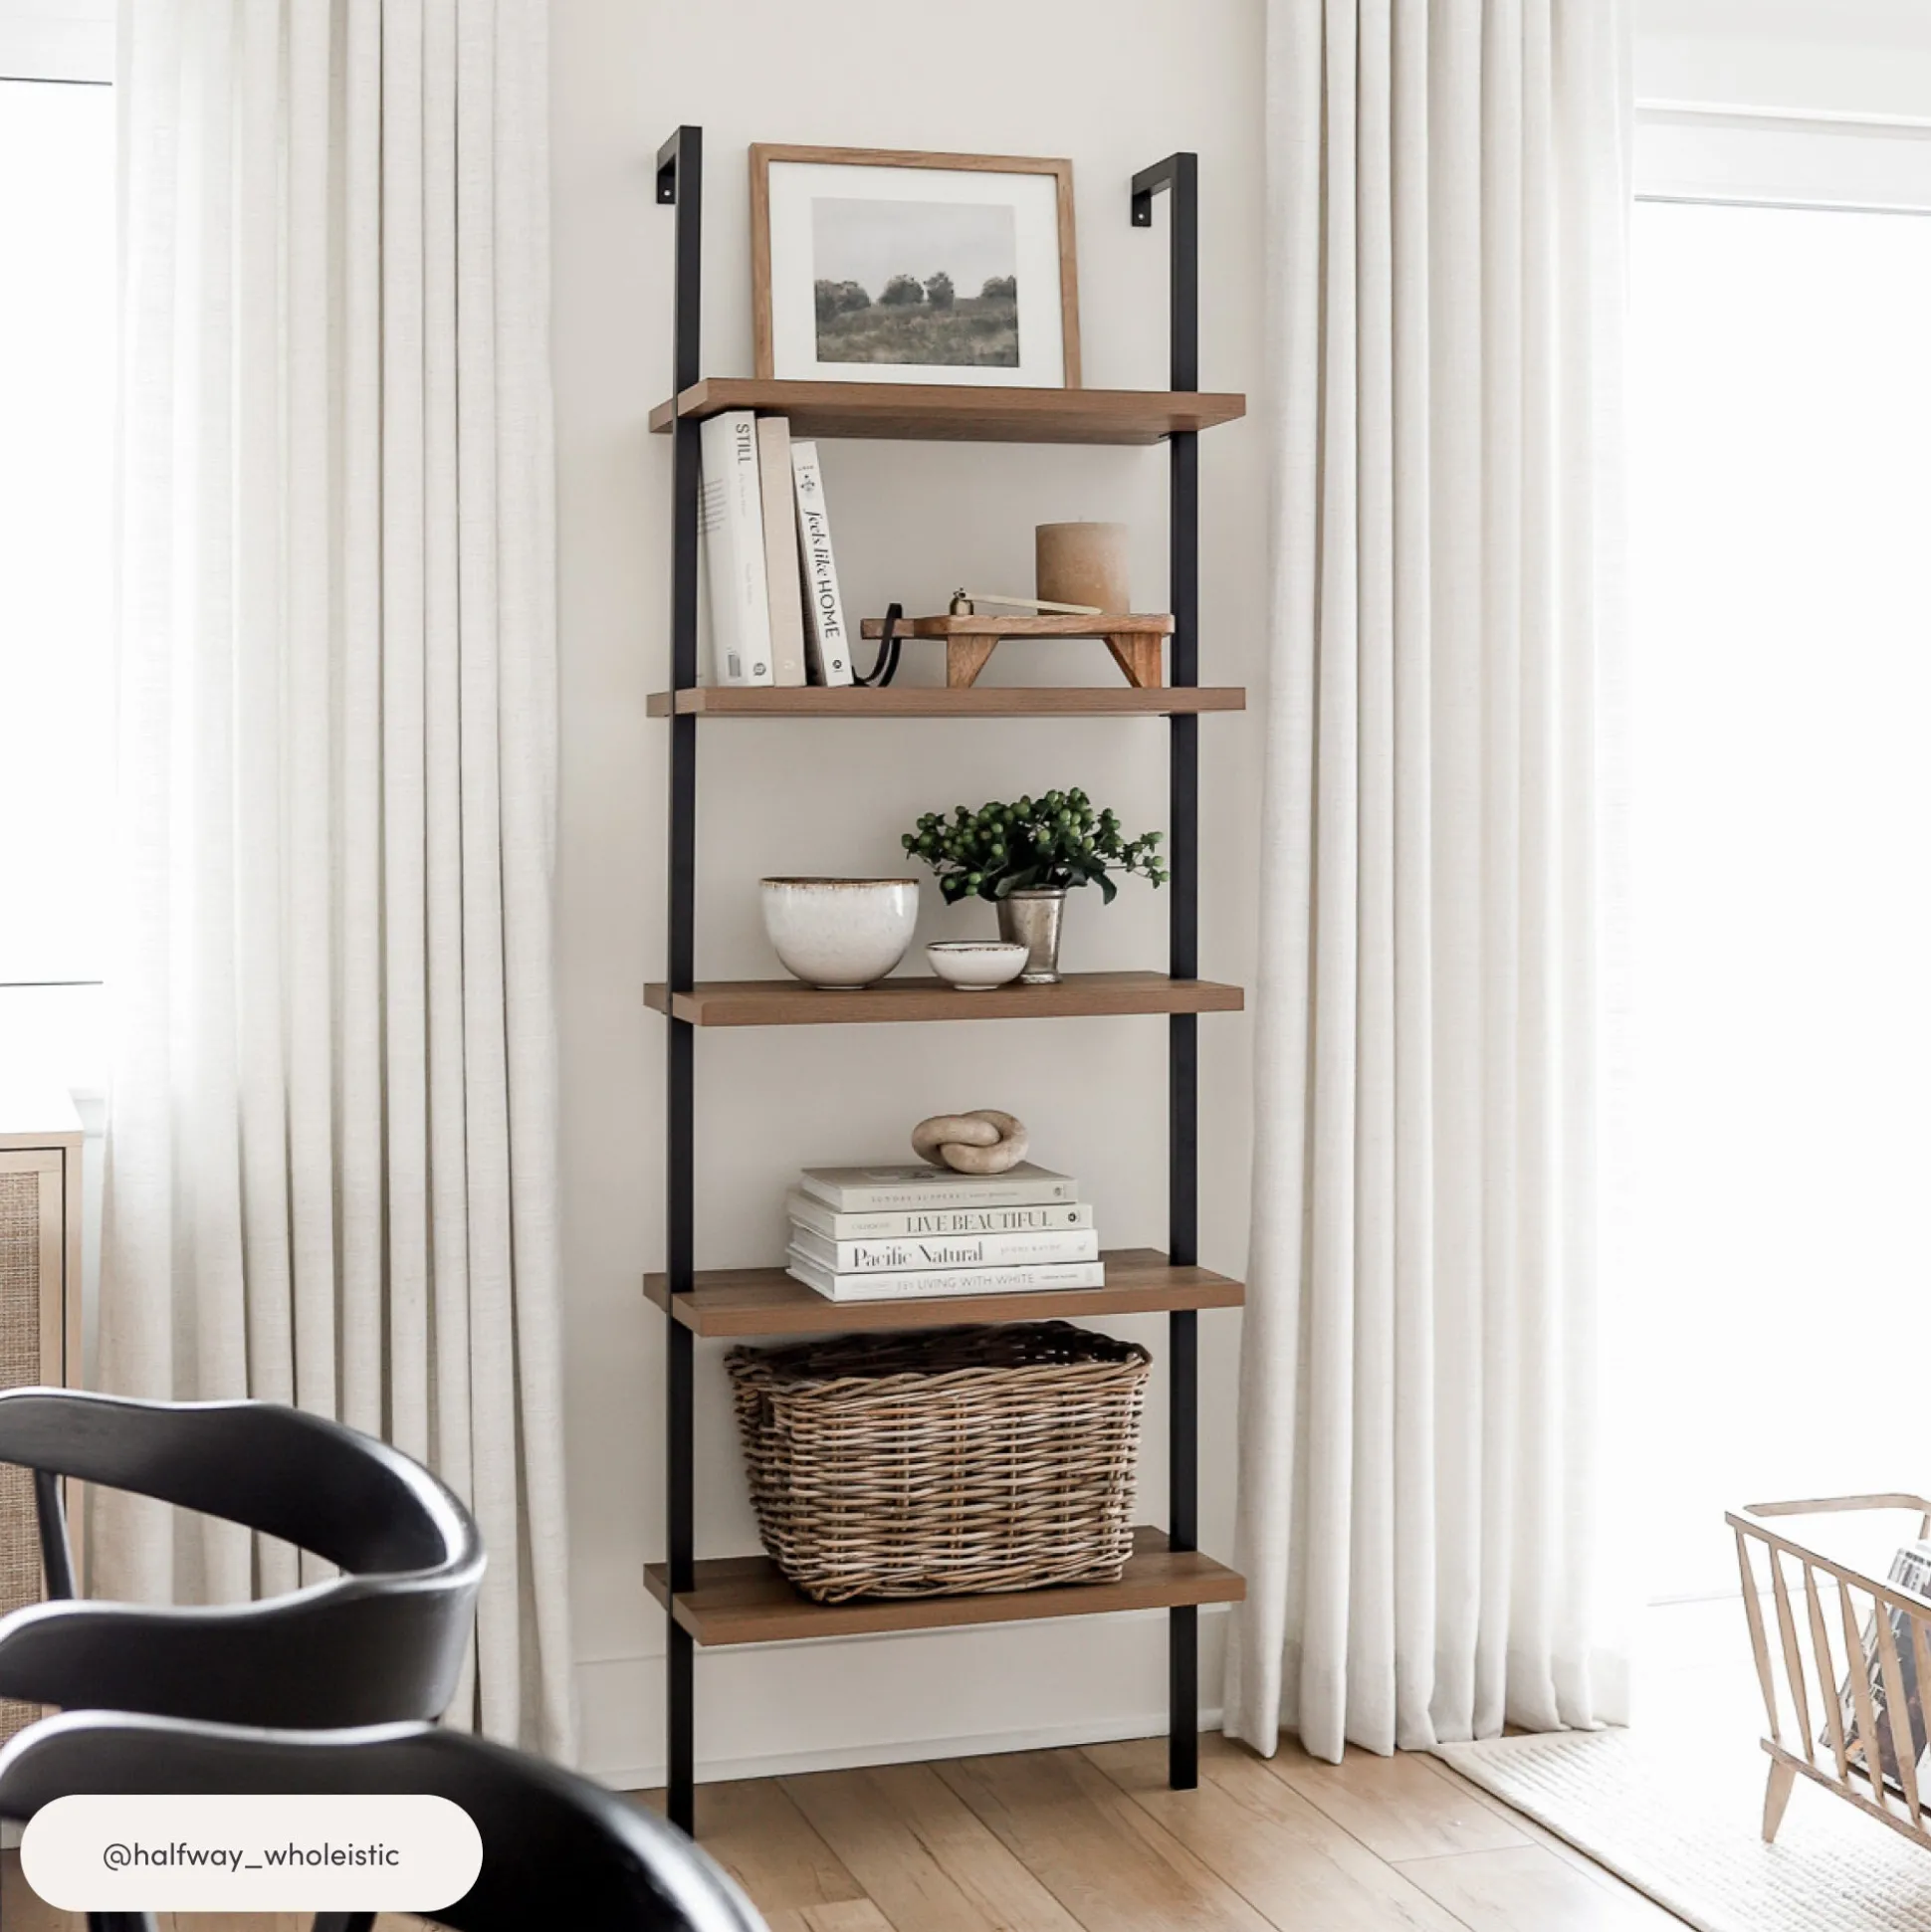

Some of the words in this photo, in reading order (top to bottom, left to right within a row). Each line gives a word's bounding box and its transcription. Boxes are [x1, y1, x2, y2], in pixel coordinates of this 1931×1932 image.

[735, 423, 752, 465] STILL
[813, 544, 834, 576] like
[816, 578, 841, 639] HOME
[906, 1213, 949, 1233] LIVE
[952, 1210, 1053, 1231] BEAUTIFUL
[853, 1244, 914, 1268] Pacific
[917, 1241, 983, 1264] Natural
[918, 1277, 957, 1289] LIVING
[961, 1275, 993, 1287] WITH
[996, 1273, 1035, 1285] WHITE
